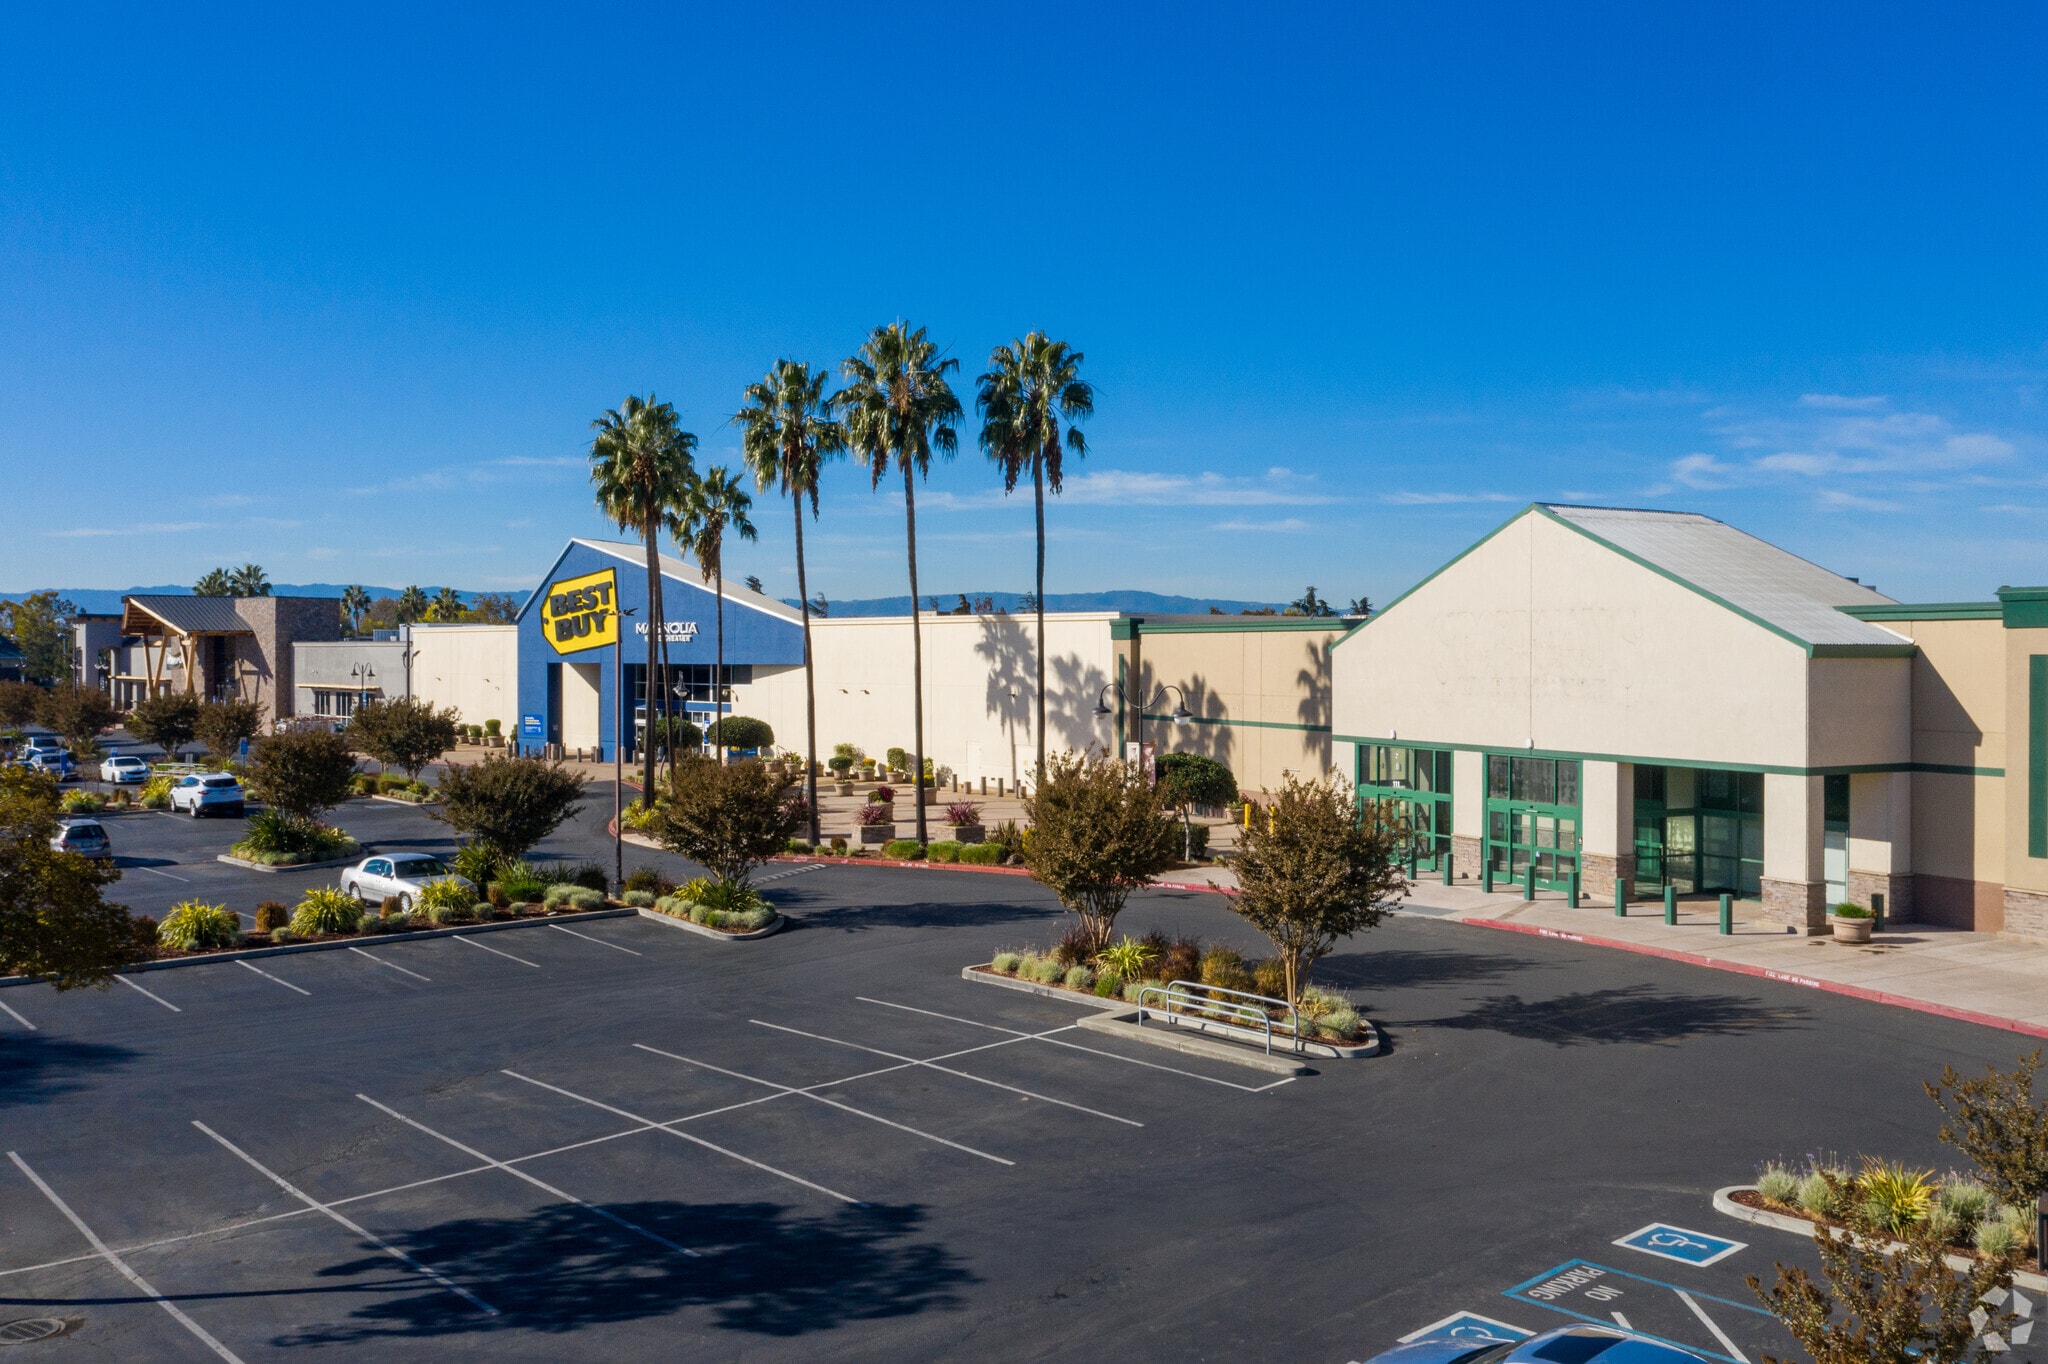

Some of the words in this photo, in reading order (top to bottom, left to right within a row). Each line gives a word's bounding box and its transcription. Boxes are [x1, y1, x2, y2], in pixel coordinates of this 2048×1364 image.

[550, 581, 613, 617] BEST
[555, 608, 609, 642] BUY
[635, 621, 698, 634] MNOLIA
[1528, 1265, 1606, 1300] PARKING
[1584, 1285, 1624, 1301] NO
